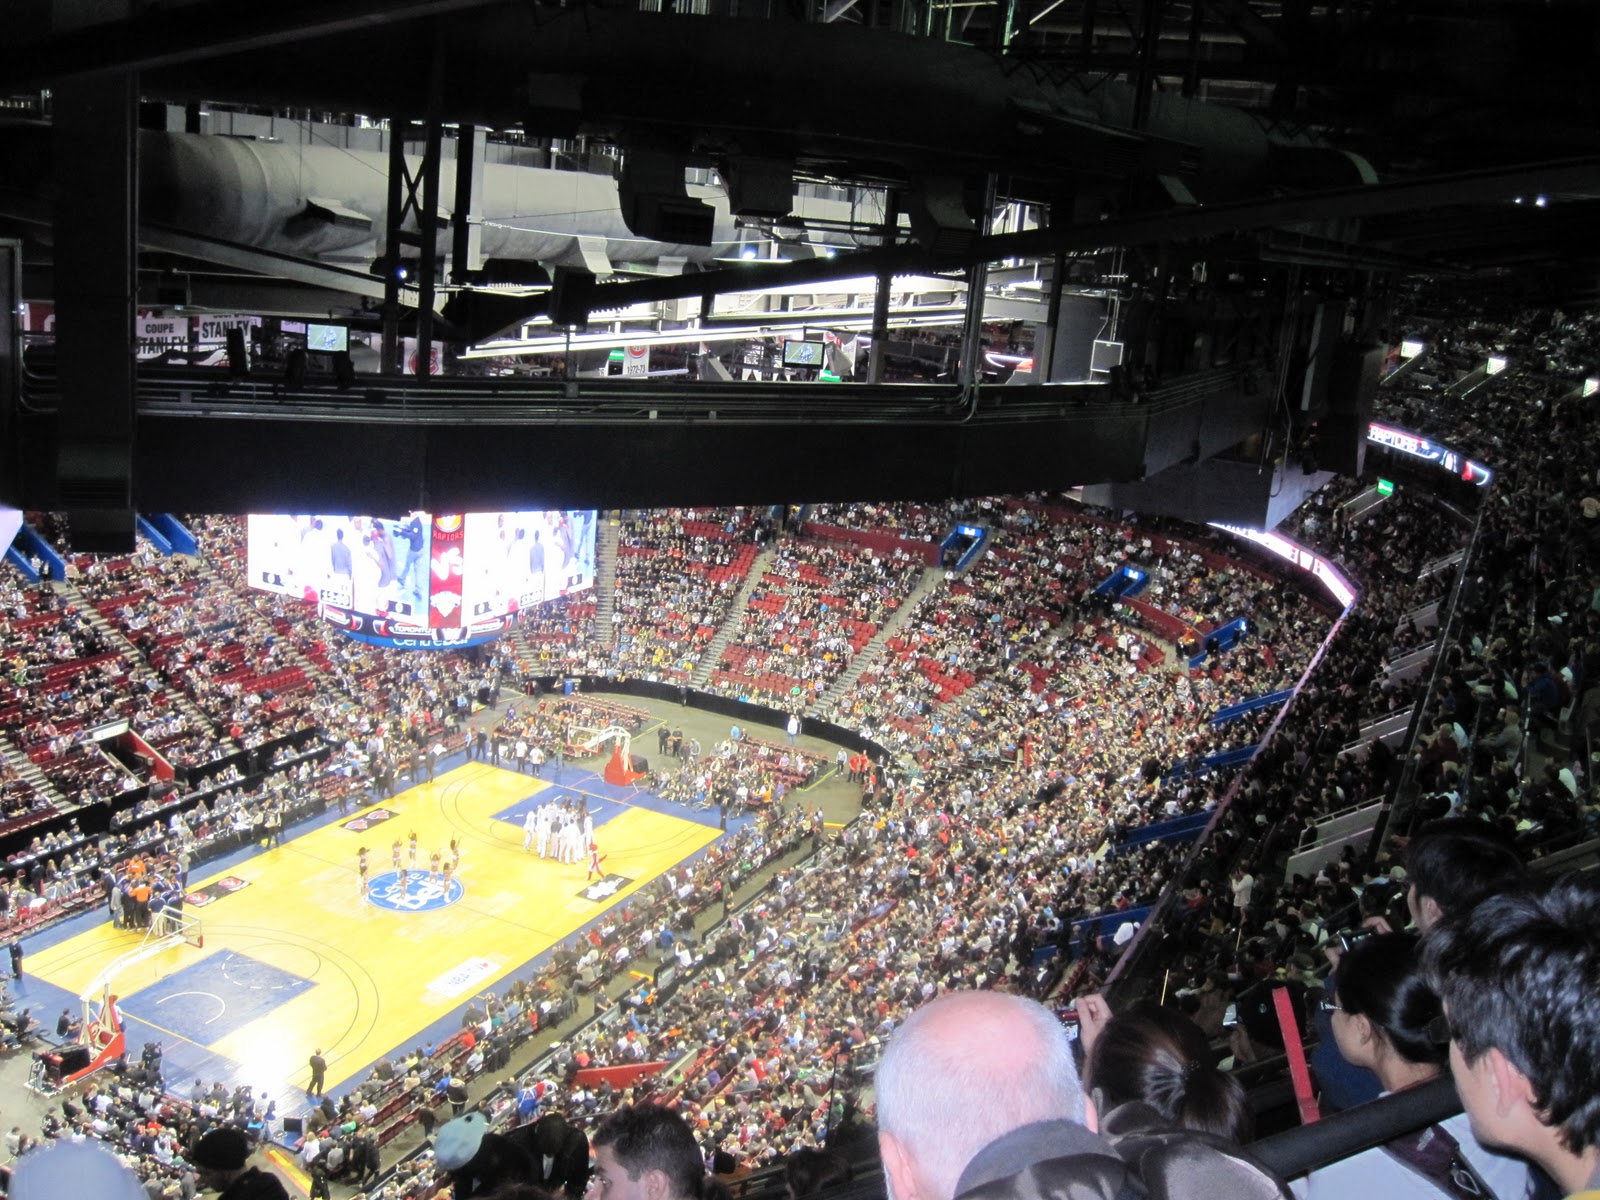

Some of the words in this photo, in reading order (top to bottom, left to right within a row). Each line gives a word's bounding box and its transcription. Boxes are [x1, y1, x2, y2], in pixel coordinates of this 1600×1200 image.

[145, 323, 174, 334] COUPE
[433, 529, 464, 542] RAPTORS
[431, 547, 463, 581] VS
